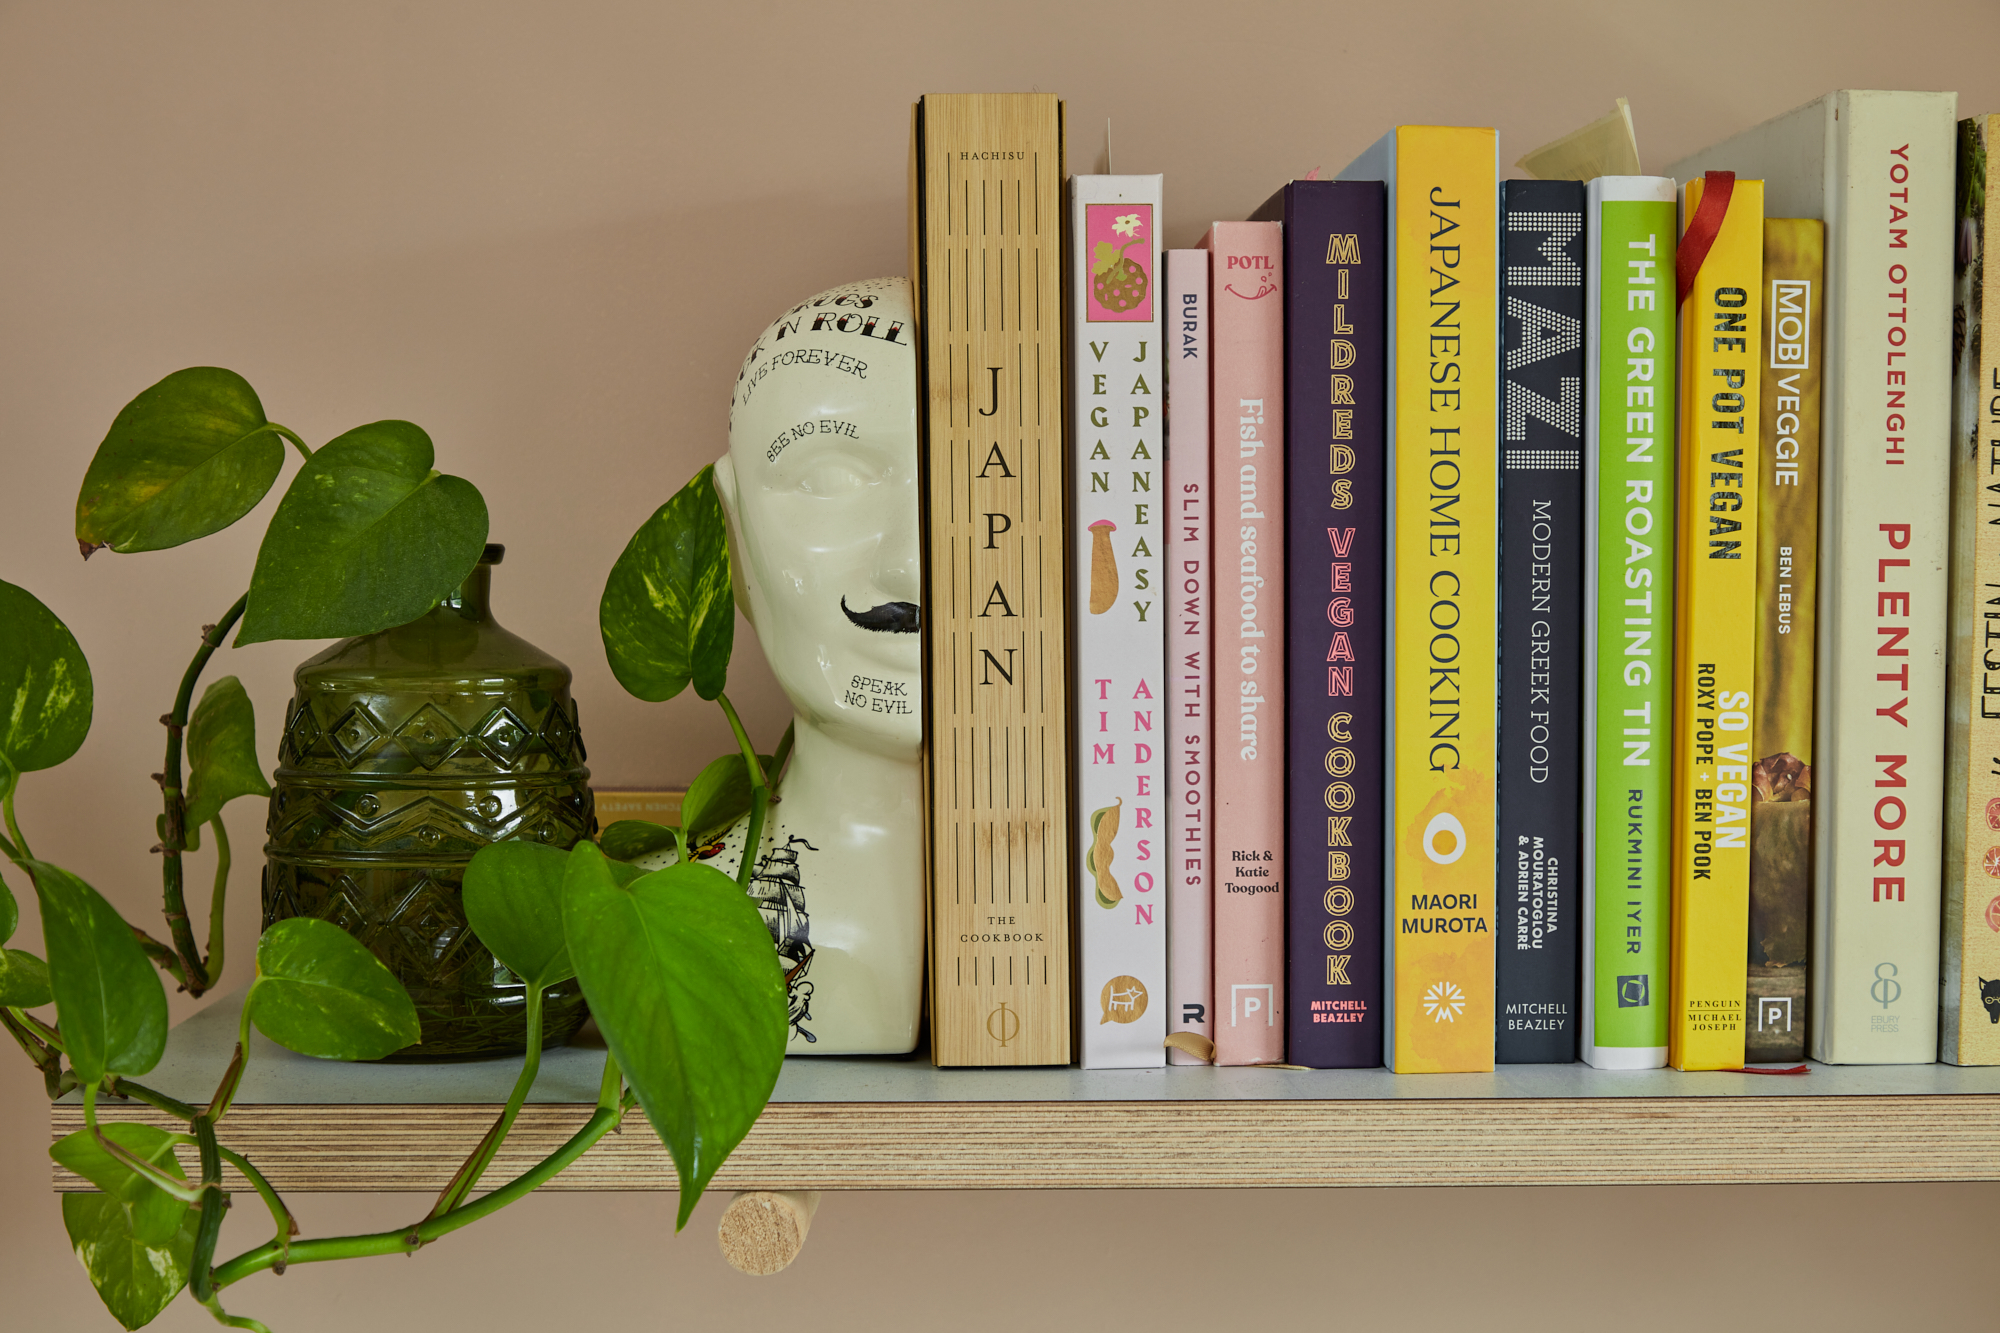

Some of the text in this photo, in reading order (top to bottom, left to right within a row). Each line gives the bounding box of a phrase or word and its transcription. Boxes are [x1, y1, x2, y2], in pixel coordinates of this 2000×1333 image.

[960, 151, 1025, 161] HACHISU
[1227, 256, 1274, 270] POTL
[810, 312, 907, 346] ROLL
[1182, 294, 1198, 359] BURAK
[1886, 143, 1909, 465] YOTAM OTTOLENGHI
[1506, 211, 1582, 471] MAZI
[743, 349, 868, 406] LIVE FOREVER
[1775, 287, 1803, 486] MOB VEGGIE
[766, 420, 860, 462] SEE NO EVIL
[1089, 341, 1111, 493] VEGAN
[1709, 287, 1747, 560] ONE POT VEGAN
[1130, 341, 1152, 622] JAPANEASY
[1429, 186, 1461, 773] JAPANESE HOME COOKING
[1623, 234, 1656, 766] THE GREEN ROASTING TIN
[975, 367, 1018, 686] JAPAN
[1240, 398, 1265, 761] Fish and seafood to share
[1778, 546, 1792, 634] BEN LEBUS
[1323, 234, 1361, 985] MILDREDS VEGAN COOKBOOK
[1530, 500, 1551, 784] MODERN GREEK FOOD
[844, 690, 912, 714] NO EVIL
[851, 675, 907, 696] SPEAK
[1183, 483, 1201, 886] SLIM DOWN WITH SMOOTHIES
[1697, 663, 1715, 710] ROXY
[1093, 679, 1115, 764] TIM
[1873, 523, 1911, 902] PLENTY MORE
[1696, 718, 1714, 765] POPE
[1715, 690, 1750, 848] SO VEGAN
[1132, 678, 1154, 925] ANDERSON
[1694, 789, 1713, 823] BEN
[1232, 850, 1273, 861] Rick &
[1235, 867, 1269, 877] Katie
[1626, 789, 1643, 954] RUKMINI IYER
[1693, 831, 1712, 880] POOK
[1225, 882, 1279, 895] Toogood
[1411, 894, 1478, 910] MAORI
[1517, 835, 1531, 950] & ADRIEN CARRÉ
[1532, 836, 1544, 949] MOURATOGLOU
[1547, 857, 1558, 933] CHRISTINA
[960, 933, 1044, 942] COOKBOOK
[987, 916, 1016, 925] THE
[1402, 918, 1488, 933] MUROTA
[1311, 1001, 1367, 1010] MITCHELL
[1313, 1013, 1364, 1023] BEAZLEY
[1506, 1003, 1567, 1014] MITCHELL
[1508, 1020, 1565, 1030] BEAZLEY
[1689, 1000, 1741, 1008] PENGUIN
[1871, 1015, 1900, 1024] EBURY
[1871, 1024, 1899, 1032] PRESS
